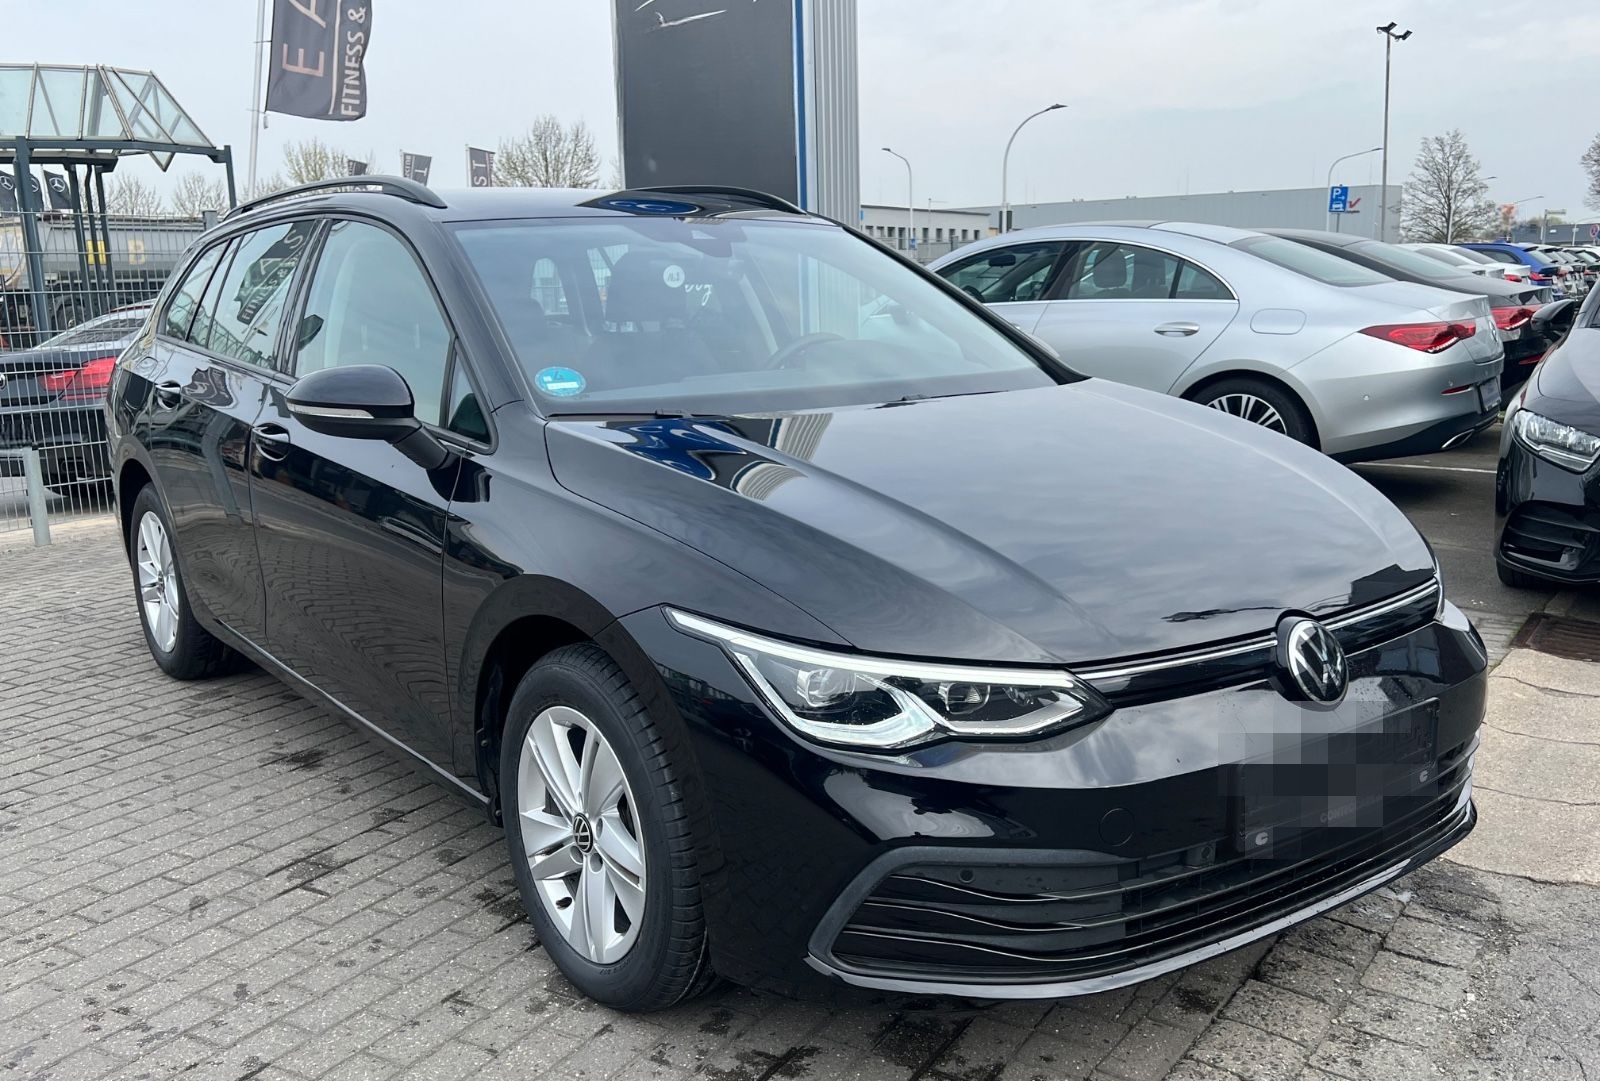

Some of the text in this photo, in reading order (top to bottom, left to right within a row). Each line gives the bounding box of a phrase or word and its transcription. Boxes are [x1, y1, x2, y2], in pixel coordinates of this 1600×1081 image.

[341, 7, 366, 116] FITNESS &
[1333, 188, 1342, 199] P
